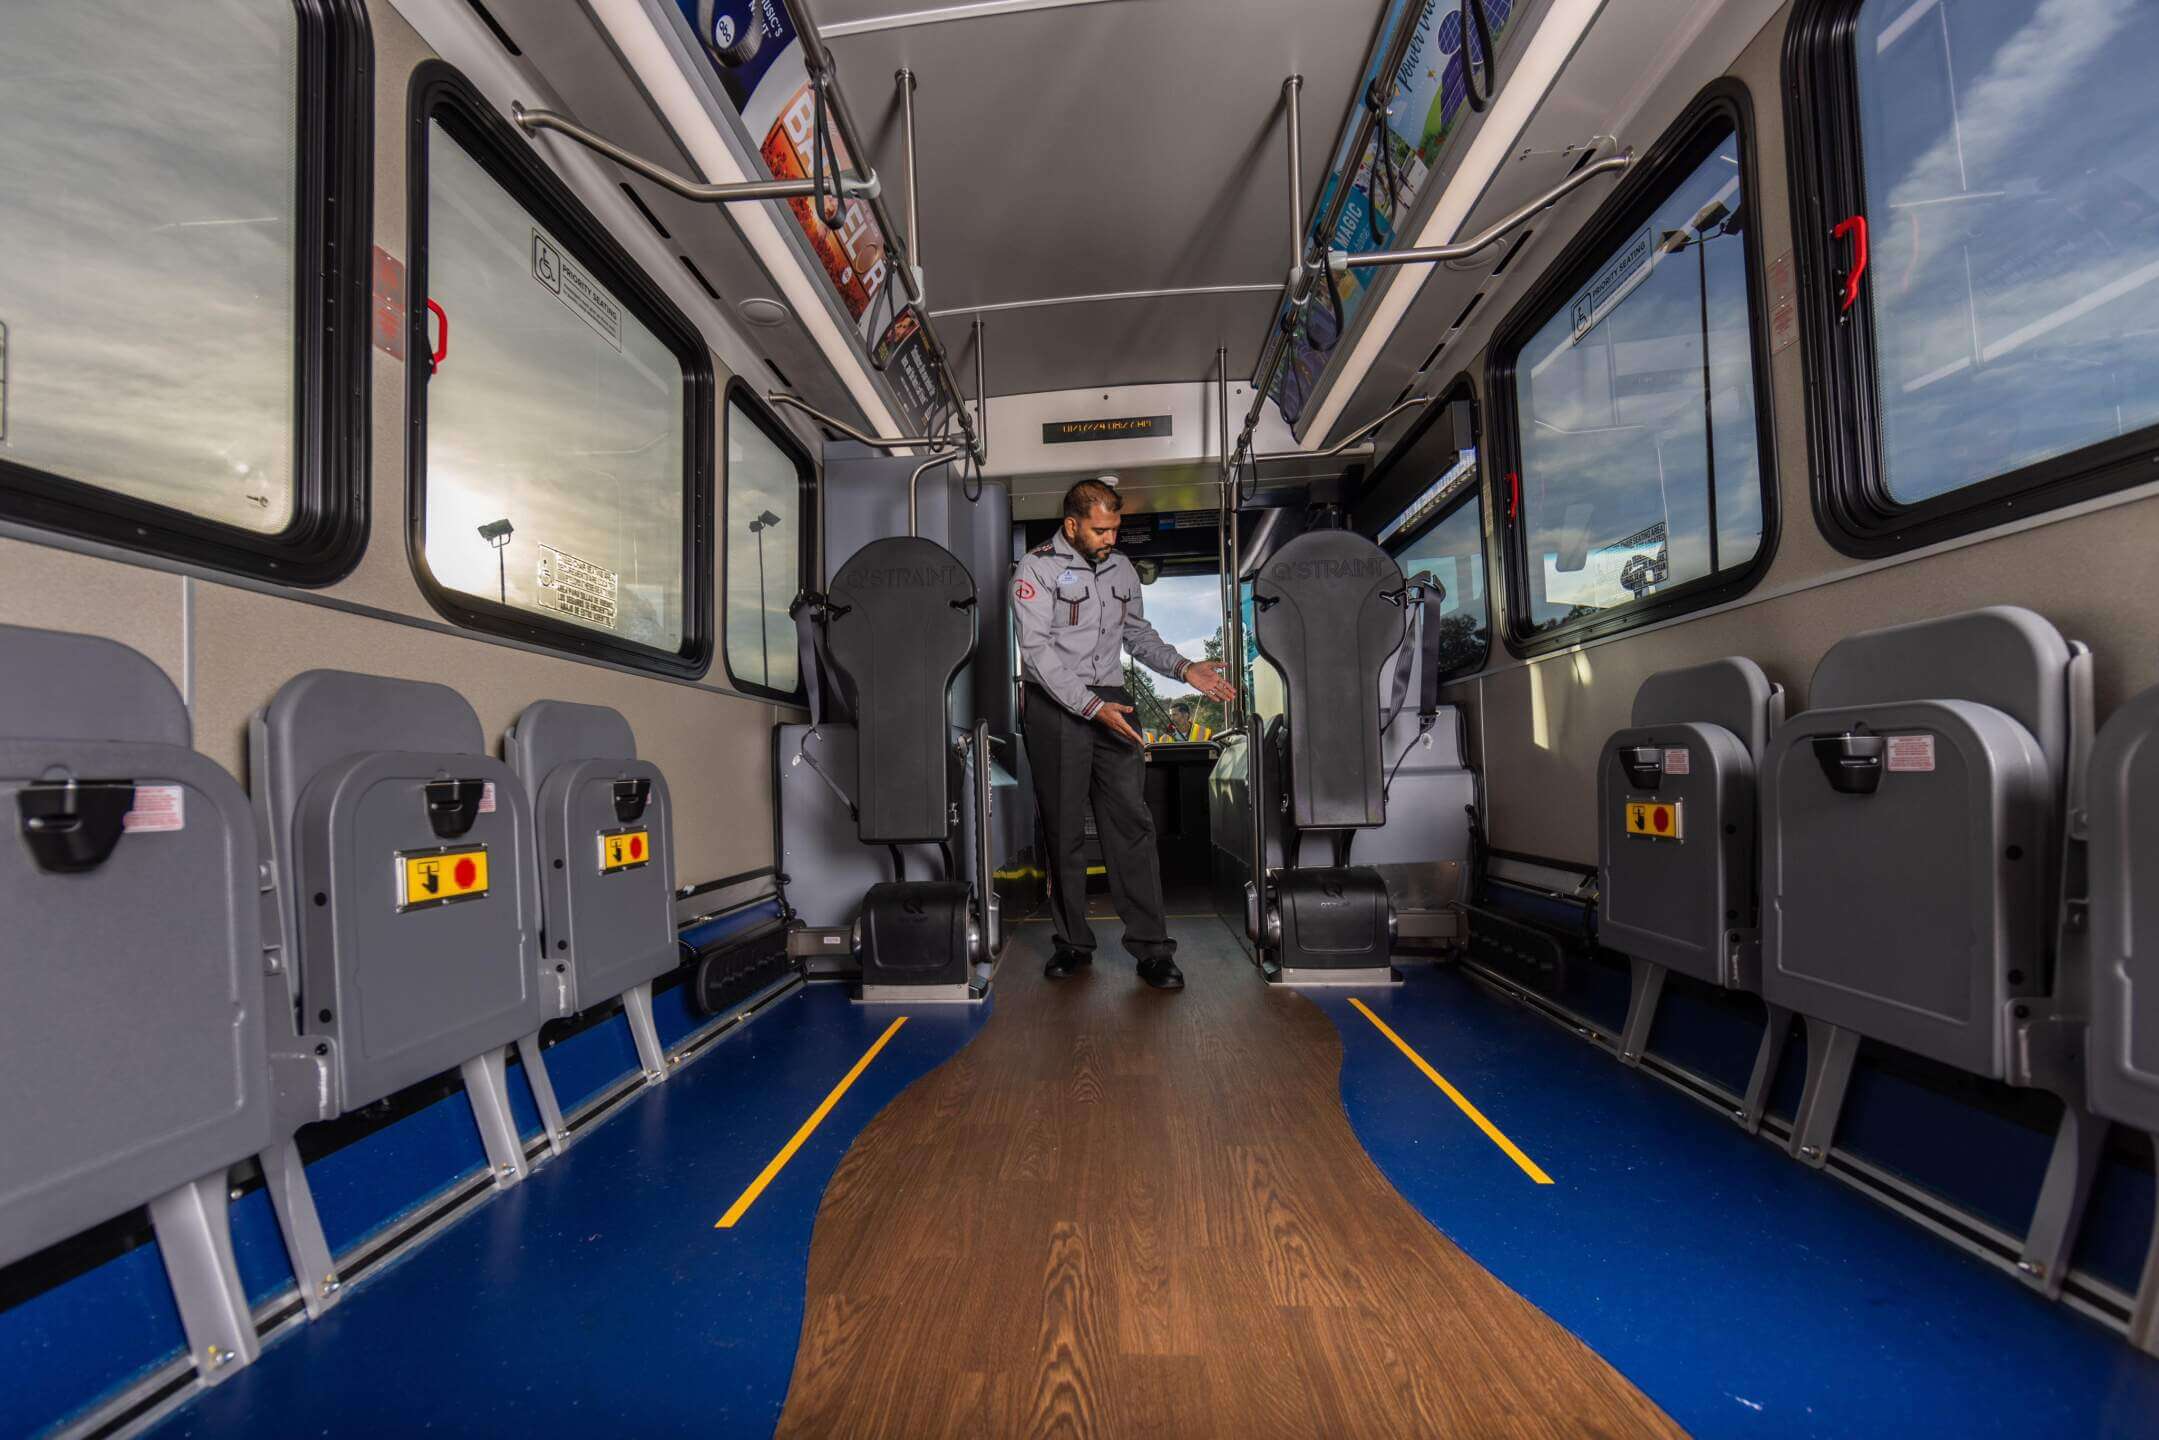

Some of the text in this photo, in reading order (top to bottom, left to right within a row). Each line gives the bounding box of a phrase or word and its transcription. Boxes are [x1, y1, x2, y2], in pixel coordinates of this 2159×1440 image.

[783, 90, 887, 297] BAELOR
[1335, 202, 1363, 249] MAGIC
[562, 263, 592, 296] PRIORITY
[592, 293, 617, 320] SEATING
[1591, 269, 1619, 298] PRIORITY
[1619, 240, 1646, 273] SEATING
